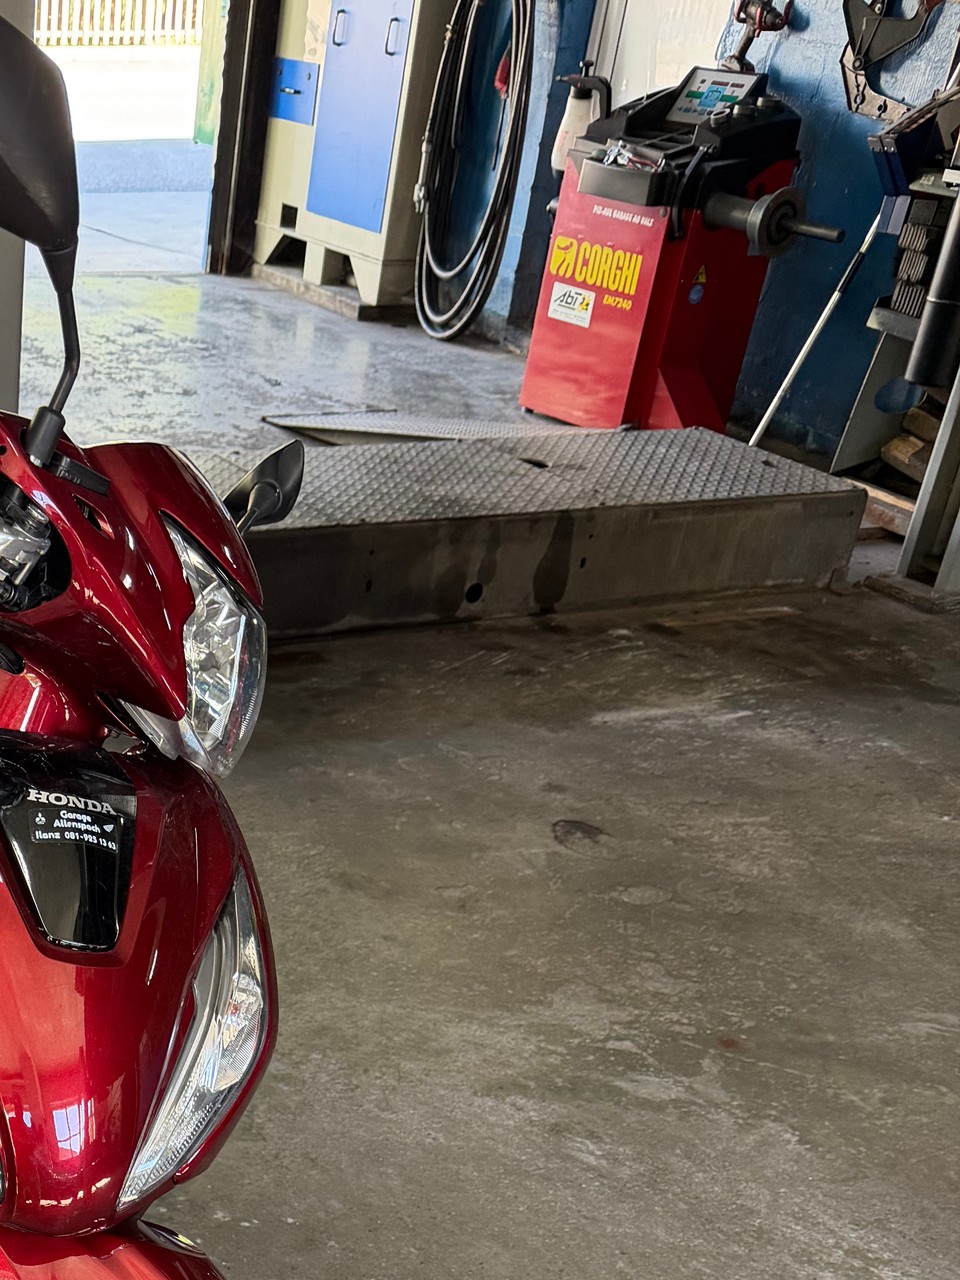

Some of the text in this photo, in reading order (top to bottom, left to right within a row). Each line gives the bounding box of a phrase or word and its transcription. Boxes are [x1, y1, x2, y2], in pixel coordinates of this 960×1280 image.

[574, 241, 643, 296] CORGHI
[26, 788, 117, 816] HONDA
[60, 810, 92, 823] Garage
[53, 819, 101, 834] Allenspach
[35, 830, 61, 840] Ilanz
